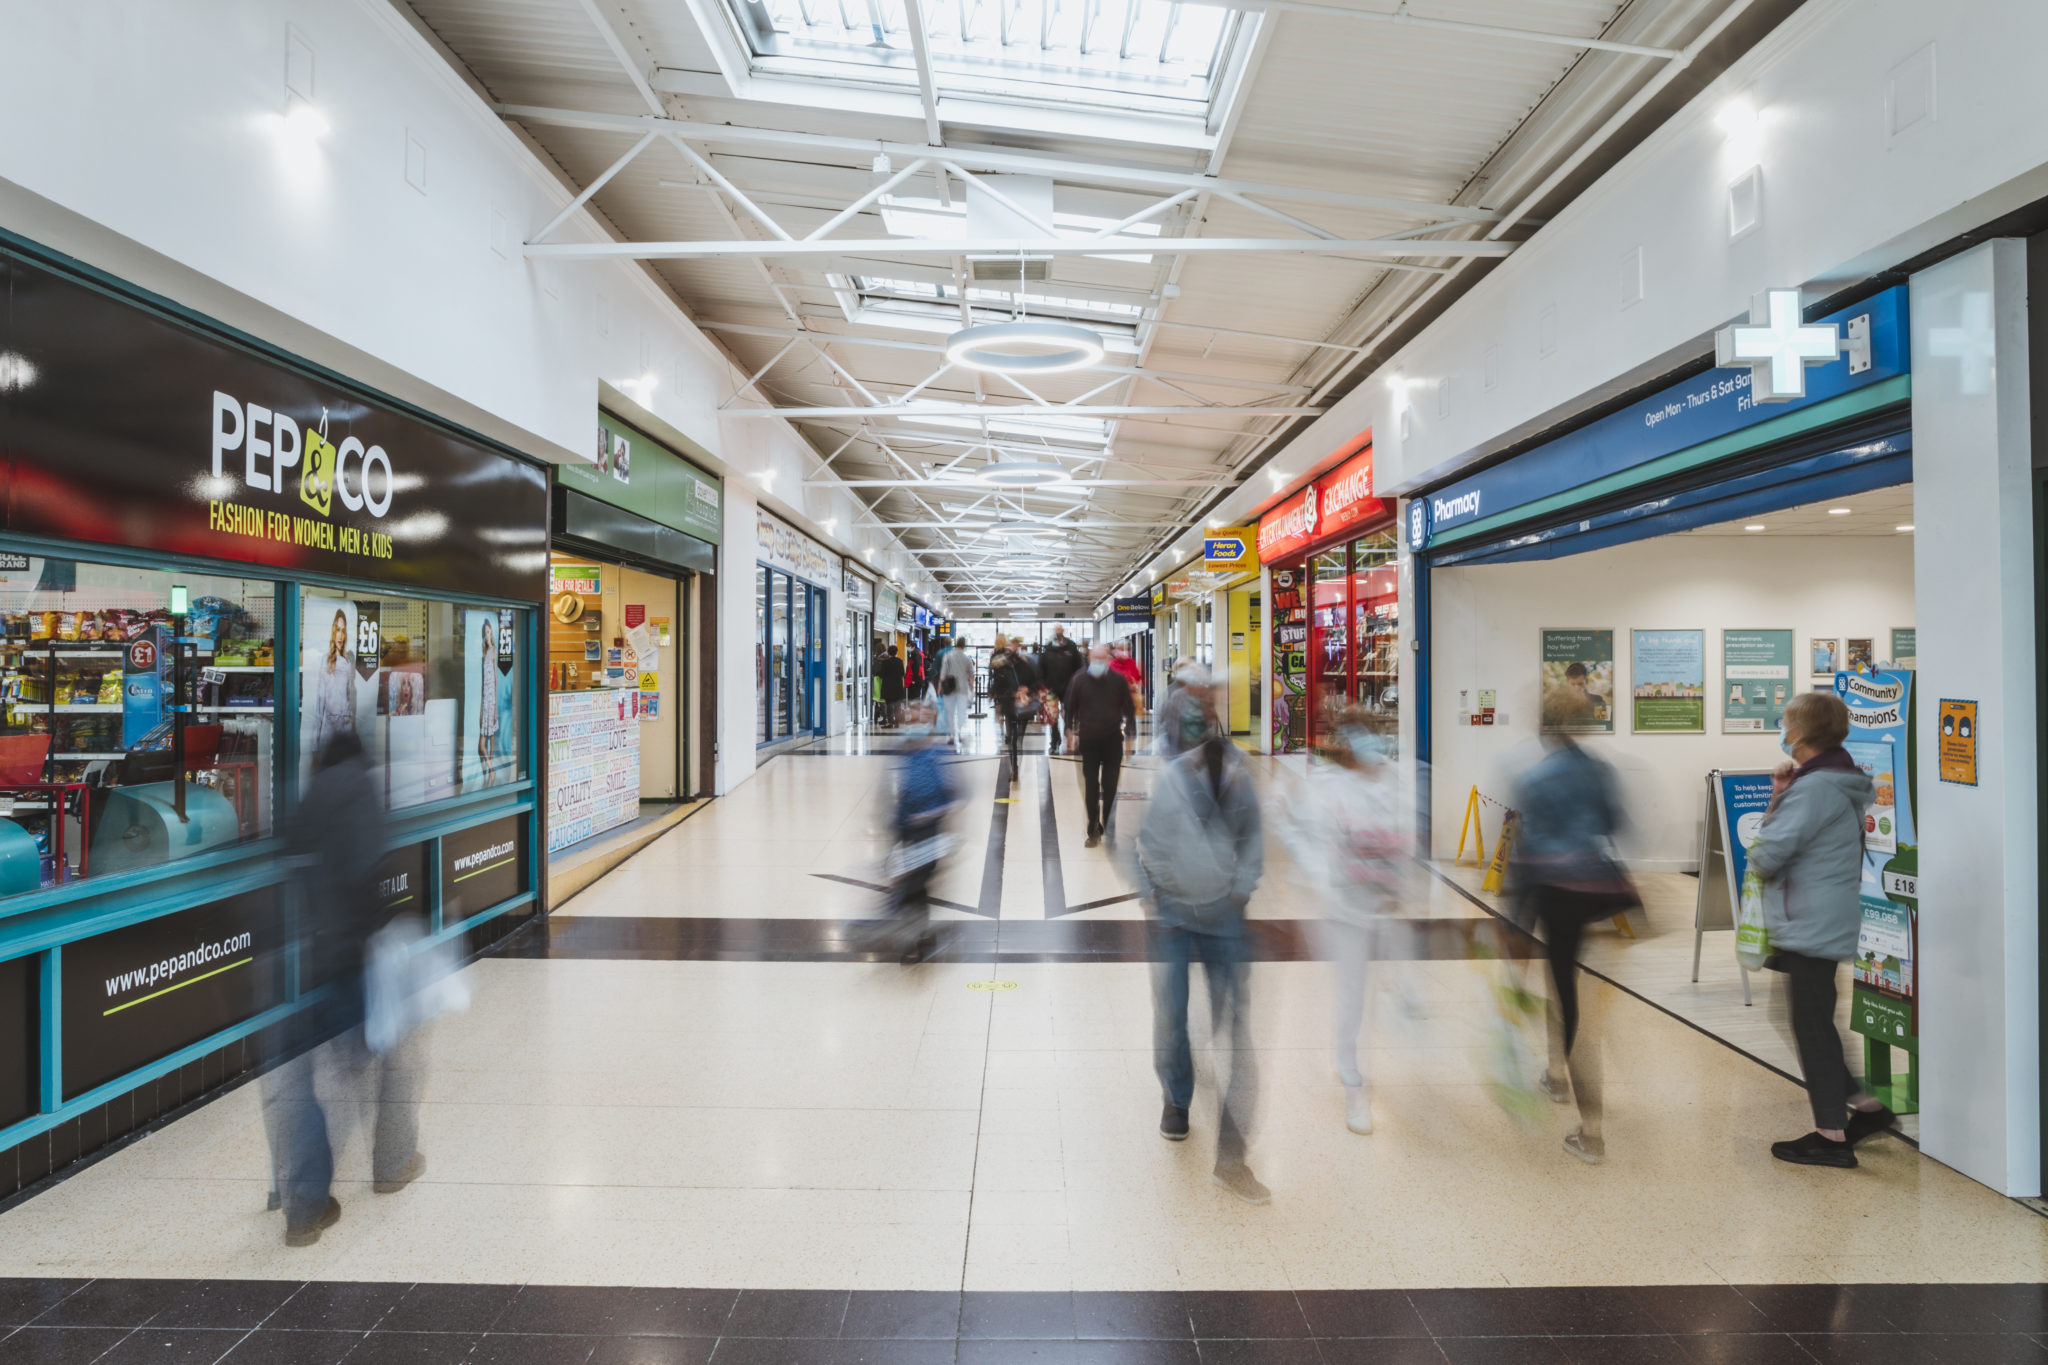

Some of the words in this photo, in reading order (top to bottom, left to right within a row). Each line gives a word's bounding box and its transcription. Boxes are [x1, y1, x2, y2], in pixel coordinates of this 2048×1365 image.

[1645, 410, 1664, 428] Open
[1665, 403, 1681, 419] Mon
[1686, 391, 1710, 409] Thurs
[1711, 385, 1717, 399] &
[1719, 379, 1735, 396] Sat
[1737, 394, 1750, 412] Fri
[212, 389, 302, 494] PEP
[336, 436, 393, 518] CO
[1324, 465, 1370, 516] EXCHANGE
[1434, 488, 1481, 523] Pharmacy
[210, 499, 264, 538] FASHION
[267, 511, 290, 543] FOR
[293, 516, 336, 553] WOMEN,
[339, 527, 360, 554] MEN
[362, 533, 369, 556] &
[372, 532, 393, 559] KIDS
[1260, 503, 1305, 549] ENTERTAINMENT
[0, 560, 27, 568] RAND
[564, 580, 574, 592] FOR
[575, 580, 594, 592] DETAILS
[1275, 589, 1300, 609] WE
[1294, 608, 1306, 619] BU
[358, 620, 379, 654] £6
[500, 628, 512, 655] £5
[1281, 628, 1306, 641] STUF
[1547, 634, 1576, 643] Suffering
[133, 646, 153, 663] £1
[1547, 643, 1559, 651] hay
[1291, 655, 1306, 668] CA
[1849, 678, 1898, 699] Community
[1848, 708, 1898, 727] hampions
[609, 729, 627, 750] LOVE
[606, 769, 627, 793] SMILE
[557, 779, 592, 811] QUALITY
[549, 817, 592, 851] LAUGHTER
[454, 840, 514, 872] www.pepandco.com
[1894, 878, 1915, 894] £18
[105, 931, 251, 997] www.pepandco.com
